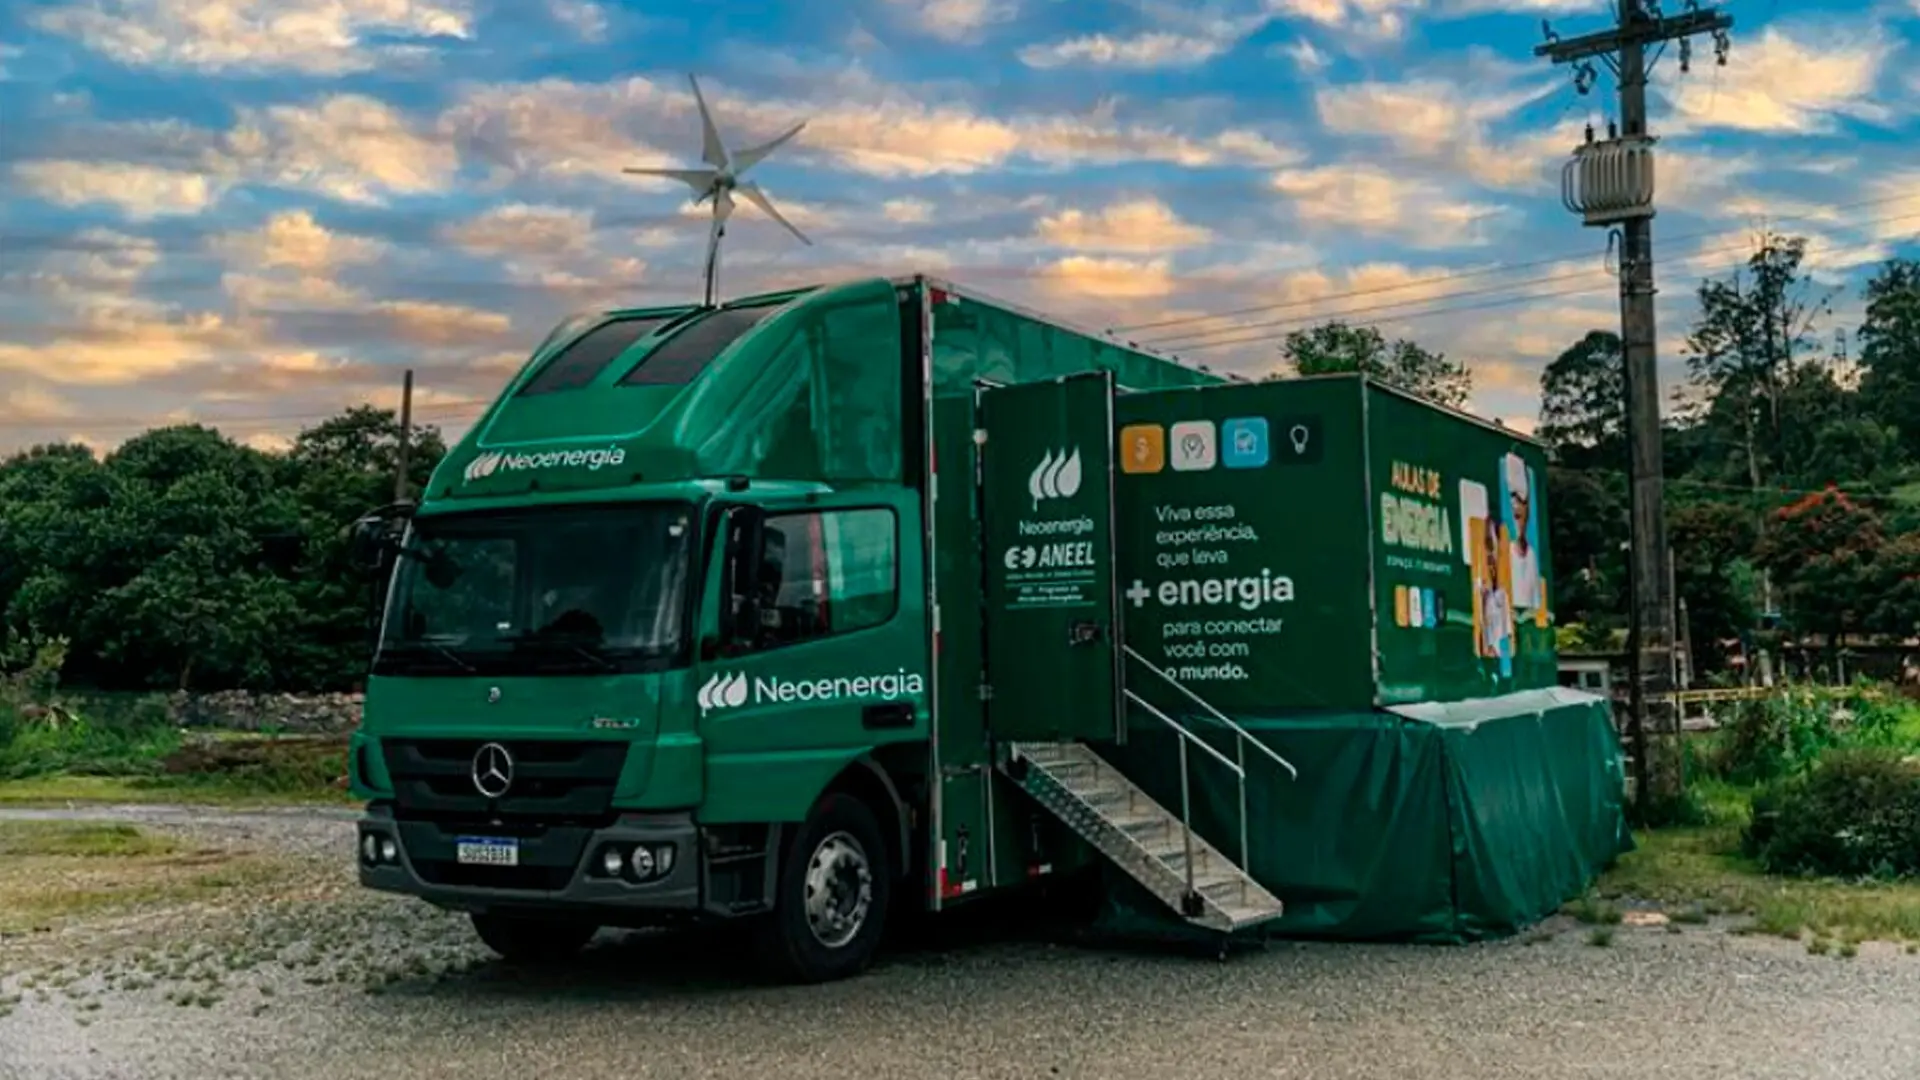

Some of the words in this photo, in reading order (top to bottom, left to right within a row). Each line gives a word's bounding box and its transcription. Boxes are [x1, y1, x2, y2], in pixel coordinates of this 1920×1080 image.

[500, 443, 626, 471] Neoenergia
[1391, 459, 1425, 495] AULAS
[1155, 504, 1191, 522] Viva
[1194, 504, 1235, 520] essa
[1381, 491, 1453, 555] ENERGIA
[1019, 514, 1095, 535] Neoenergia
[1155, 523, 1259, 545] experiência,
[1038, 541, 1096, 567] ANEEL
[1156, 552, 1189, 568] que
[1193, 548, 1228, 564] leva
[1158, 567, 1295, 610] energia
[1162, 622, 1201, 638] para
[1204, 616, 1283, 635] conectar
[1163, 641, 1205, 657] você
[1209, 643, 1250, 656] com
[1165, 667, 1177, 680] o
[1179, 662, 1249, 680] mundo.
[754, 667, 924, 703] Neoenergia
